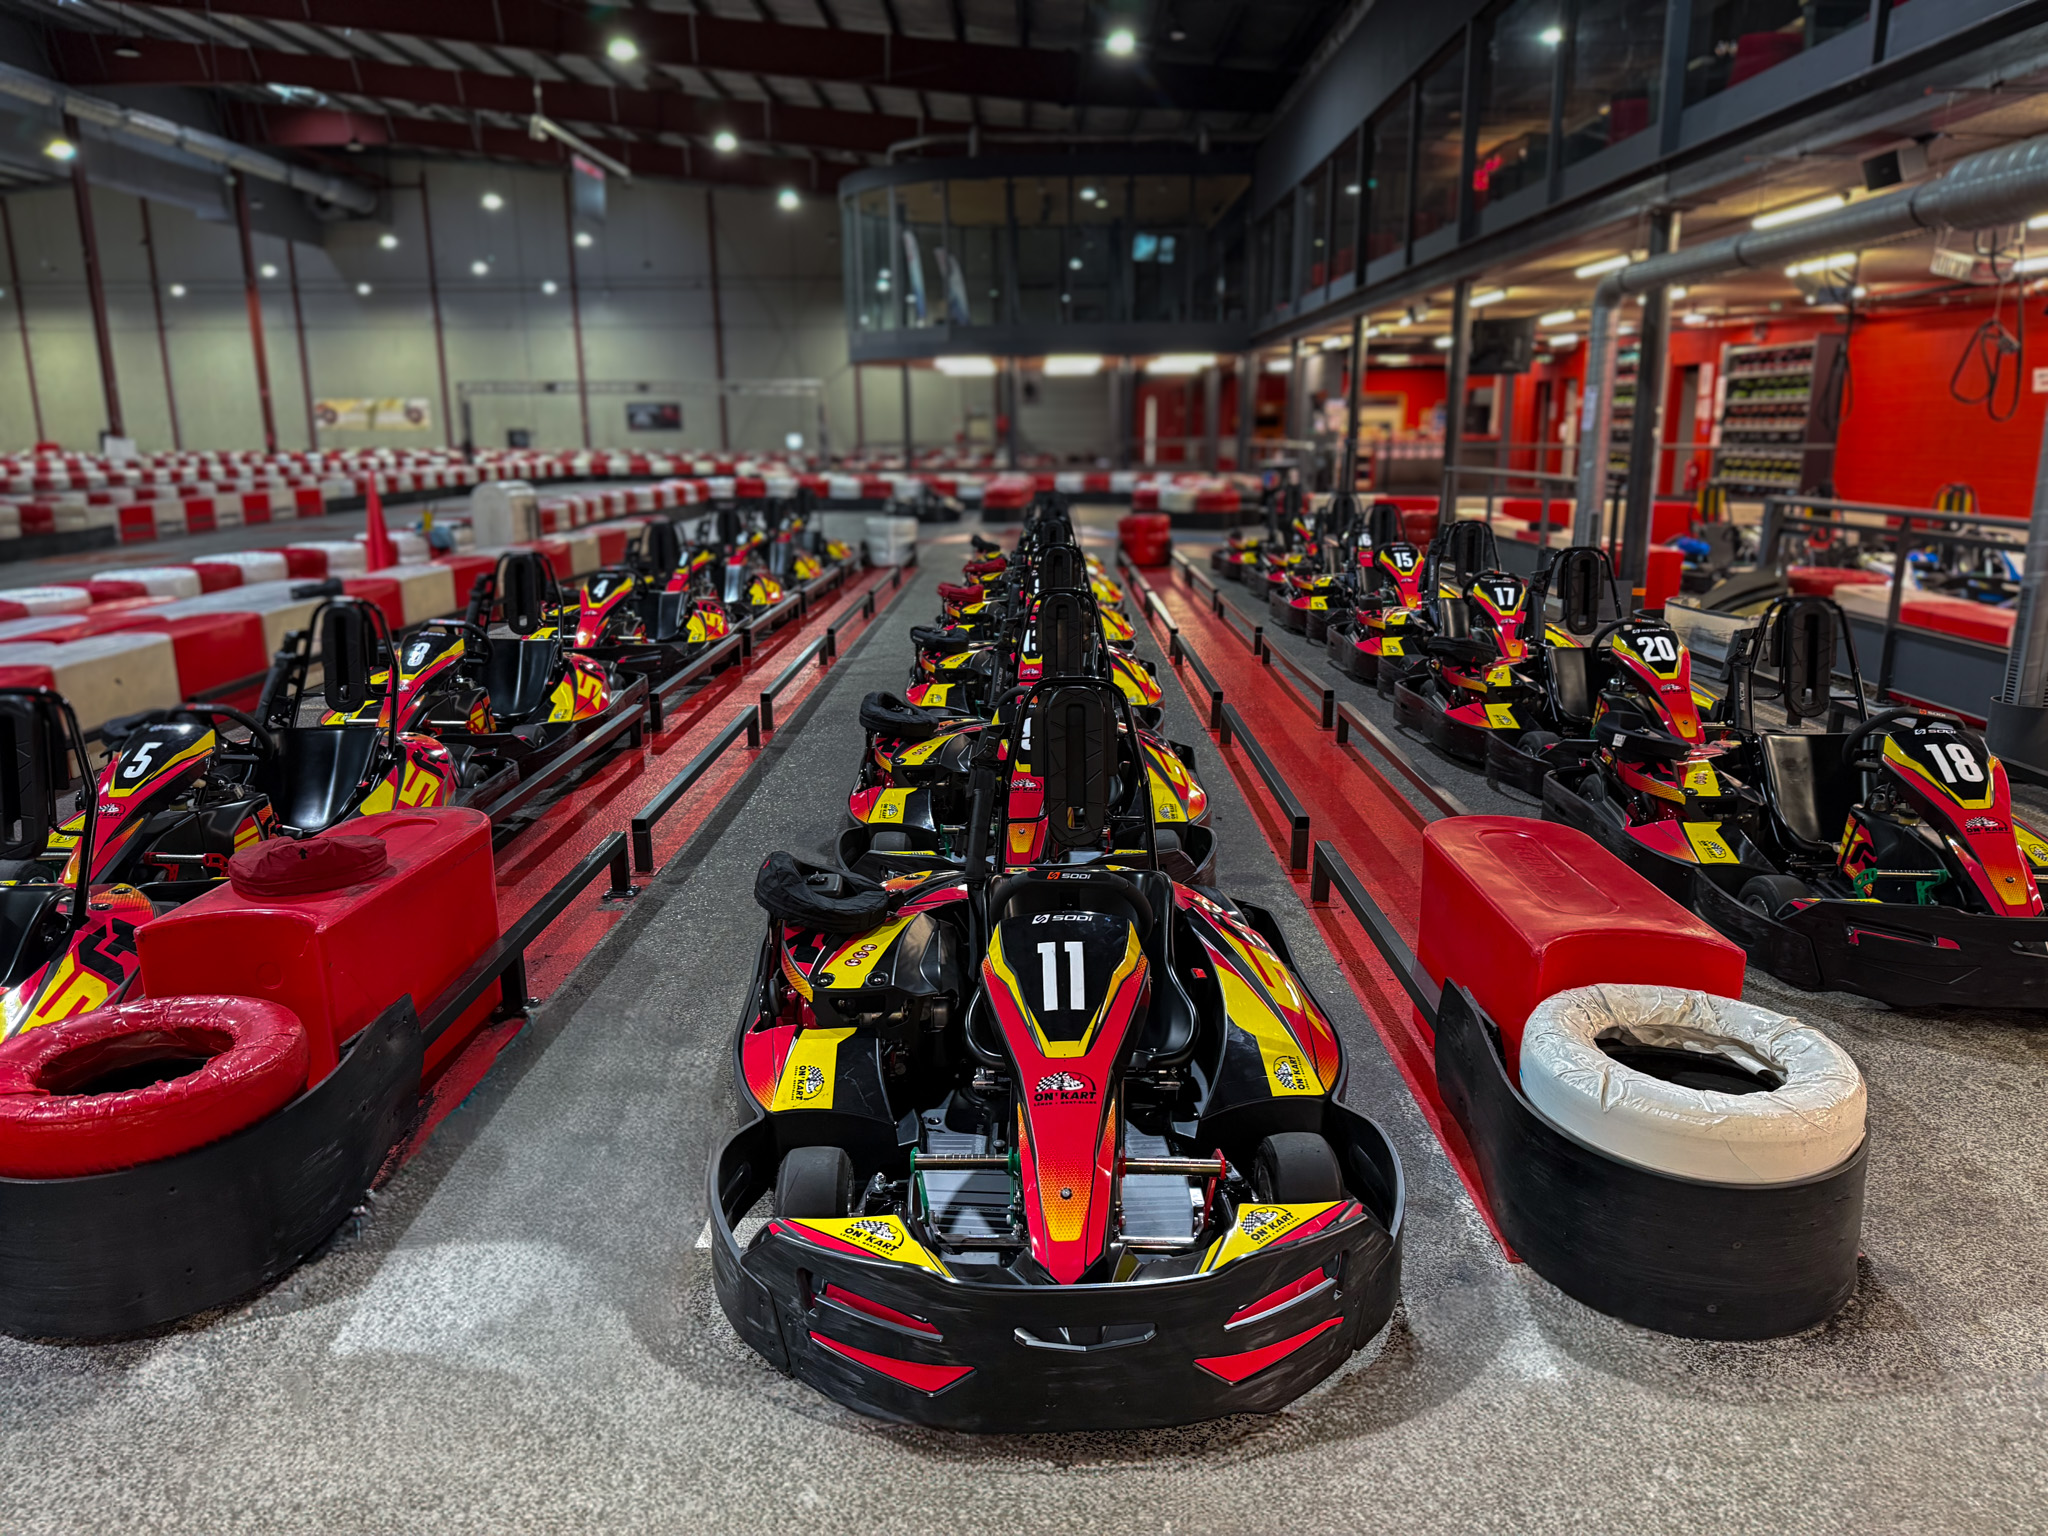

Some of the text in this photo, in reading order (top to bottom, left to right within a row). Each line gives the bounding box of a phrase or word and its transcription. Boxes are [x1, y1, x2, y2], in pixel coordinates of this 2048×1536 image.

[1393, 552, 1414, 568] 15
[592, 579, 609, 598] 4
[1493, 587, 1516, 606] 17
[407, 642, 431, 667] 8
[1636, 636, 1677, 662] 20
[123, 742, 163, 778] 5
[1923, 743, 1985, 784] 18
[1037, 941, 1086, 1012] 11
